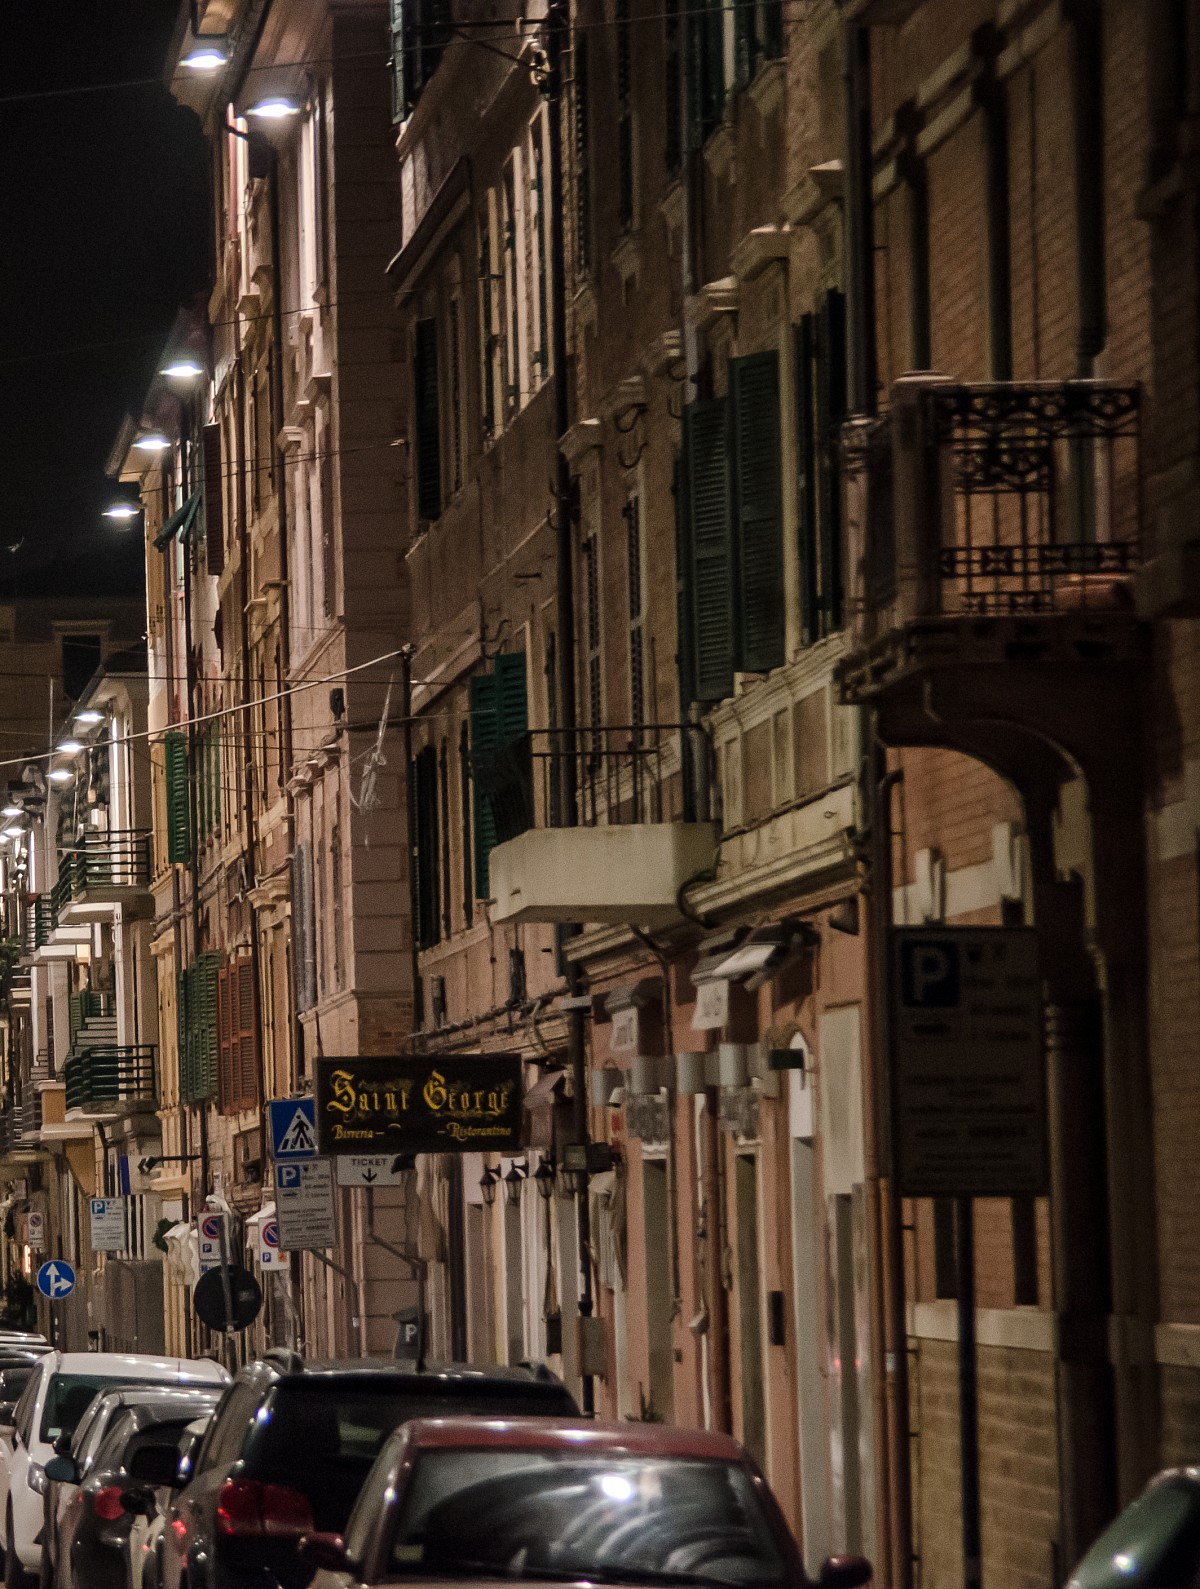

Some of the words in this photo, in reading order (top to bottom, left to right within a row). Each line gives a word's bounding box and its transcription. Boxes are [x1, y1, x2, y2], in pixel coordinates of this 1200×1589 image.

[912, 946, 949, 1000] P
[327, 1070, 409, 1115] Saint
[423, 1069, 509, 1117] George
[332, 1124, 374, 1140] Birreria
[447, 1122, 512, 1141] Ristorantino
[351, 1157, 388, 1167] TICKET
[282, 1167, 297, 1187] P
[94, 1201, 103, 1213] P
[264, 1253, 271, 1262] P
[405, 1324, 417, 1342] P
